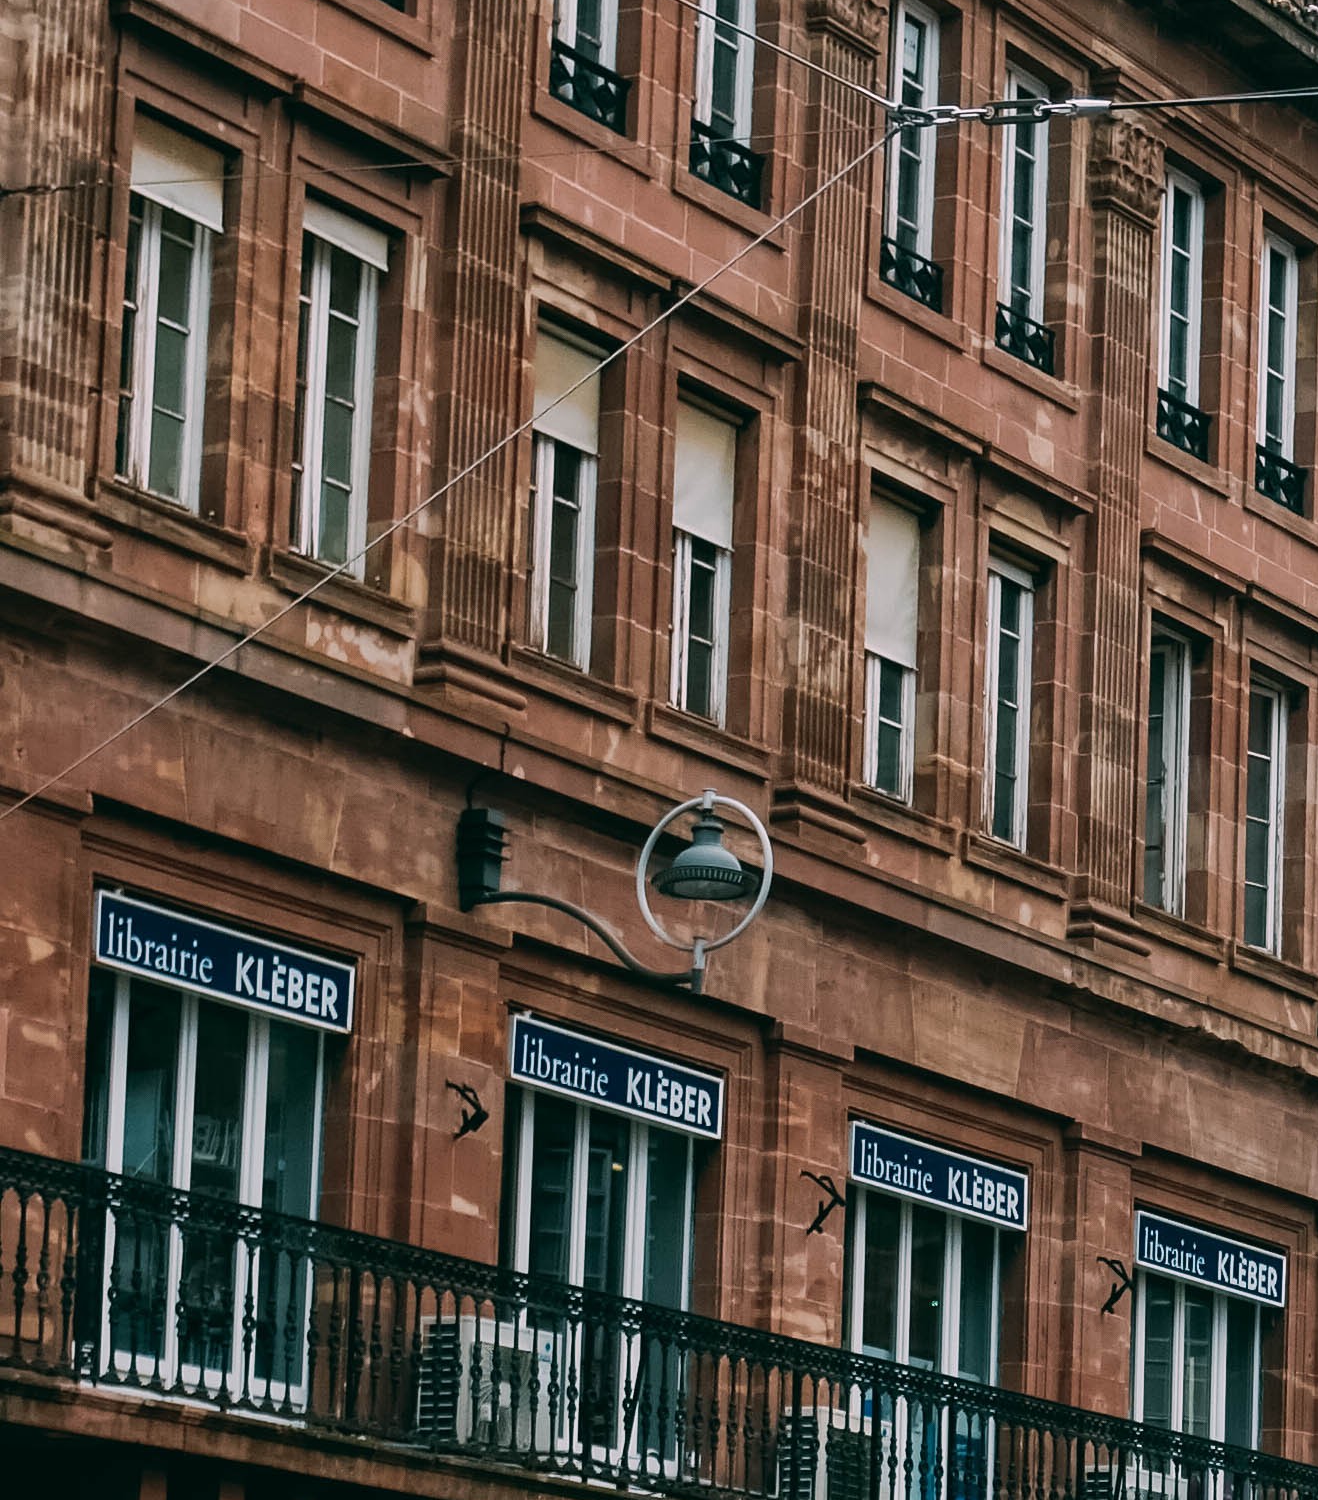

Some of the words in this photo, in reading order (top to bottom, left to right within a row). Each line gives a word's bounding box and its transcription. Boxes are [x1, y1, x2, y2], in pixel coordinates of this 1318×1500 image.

[106, 912, 214, 984] librairie
[521, 1034, 609, 1097] librairie
[860, 1139, 933, 1194] librairie
[1144, 1226, 1206, 1276] librairie
